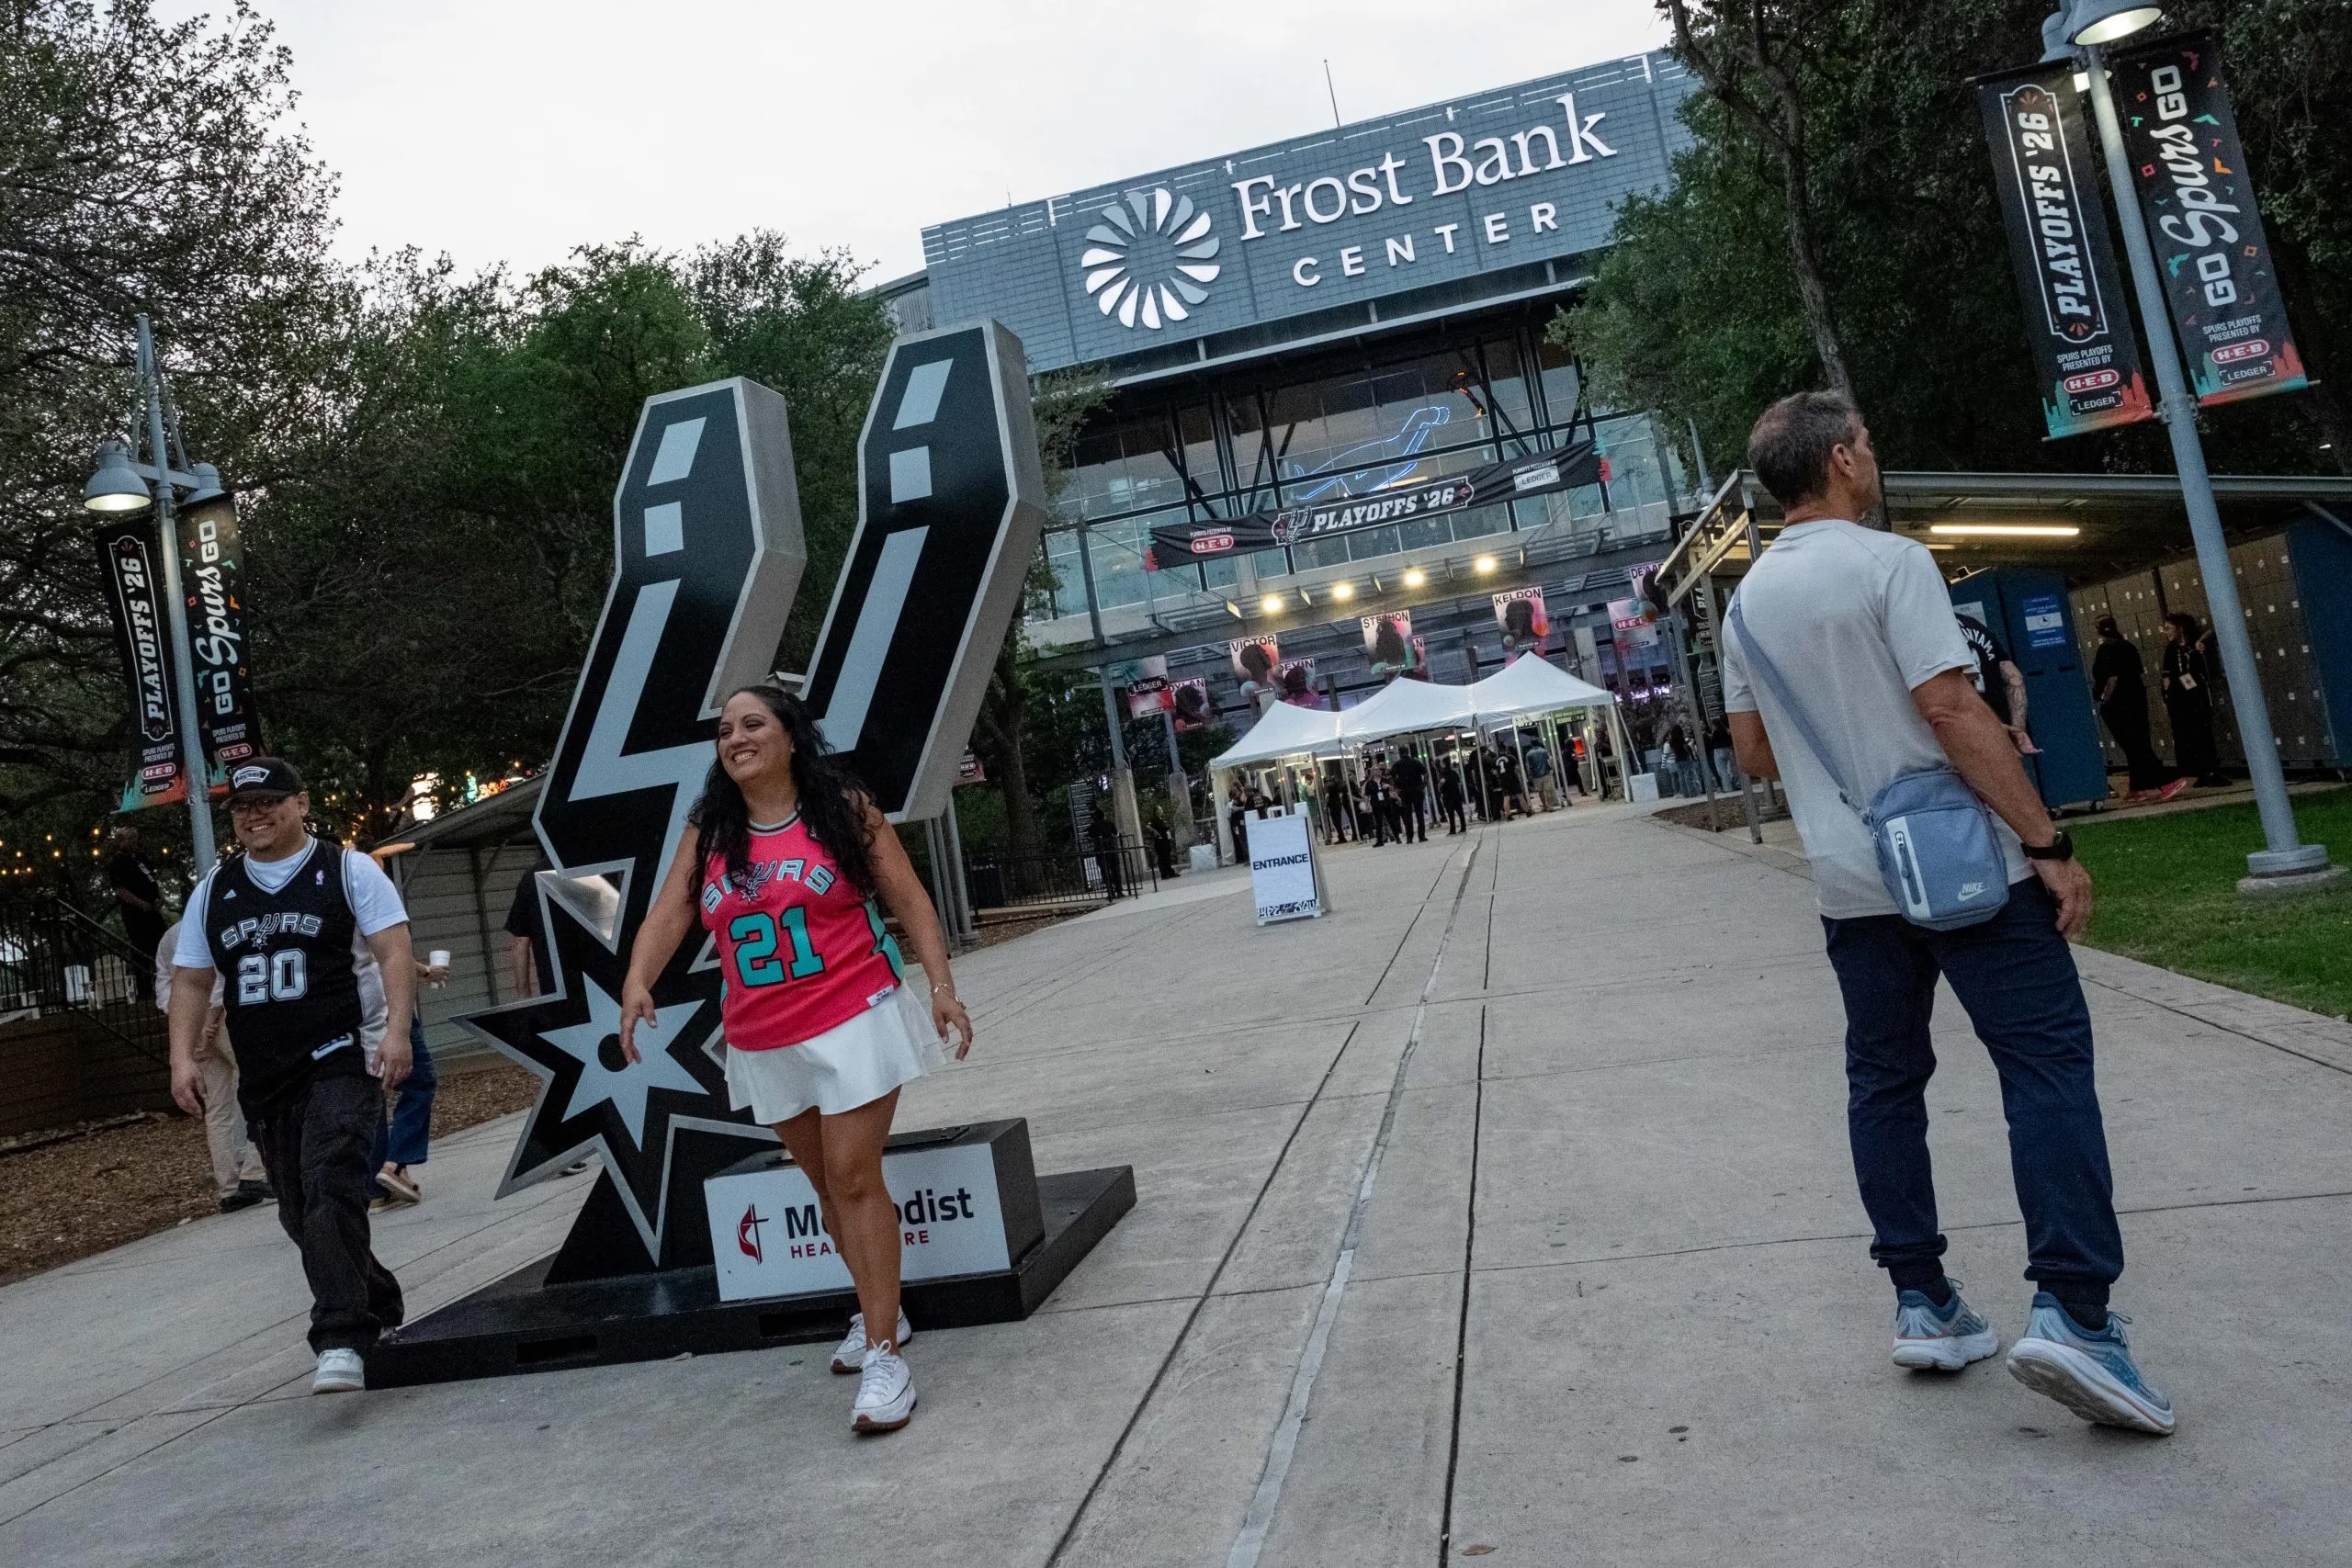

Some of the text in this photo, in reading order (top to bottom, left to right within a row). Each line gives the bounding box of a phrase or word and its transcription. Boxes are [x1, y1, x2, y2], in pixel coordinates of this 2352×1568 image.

[1231, 93, 1617, 241] Frost Bank
[2150, 65, 2241, 306] GO Spurs GO
[2018, 112, 2092, 317] PLAYOFFS '26
[1293, 201, 1559, 288] CENTER
[2202, 314, 2262, 334] SPURS PLAYOFFS
[2209, 323, 2260, 343] PRESENTED BY
[2057, 344, 2113, 364] SPURS PLAYOFFS
[2063, 355, 2111, 371] PRESENTED BY
[2227, 366, 2267, 380] LEDGER
[2077, 396, 2116, 411] LEDGER
[1521, 472, 1552, 485] LEDGER
[1312, 487, 1454, 533] PLAYOFFS '26
[1494, 588, 1542, 606] KELDON
[196, 520, 241, 715] GO Spurs GO
[1363, 612, 1408, 628] STEPHON
[121, 558, 165, 720] PLAYOFFS '26
[1231, 636, 1276, 652] VICTOR
[1133, 681, 1162, 693] LEDGER
[145, 784, 170, 793] LEDGER
[1252, 853, 1309, 871] ENTRANCE
[1962, 882, 1984, 894] NIKE
[220, 913, 322, 950] SPURS
[729, 907, 825, 988] 21
[238, 948, 307, 1006] 20
[785, 1188, 974, 1239] Mdist
[790, 1230, 930, 1259] HEARE
